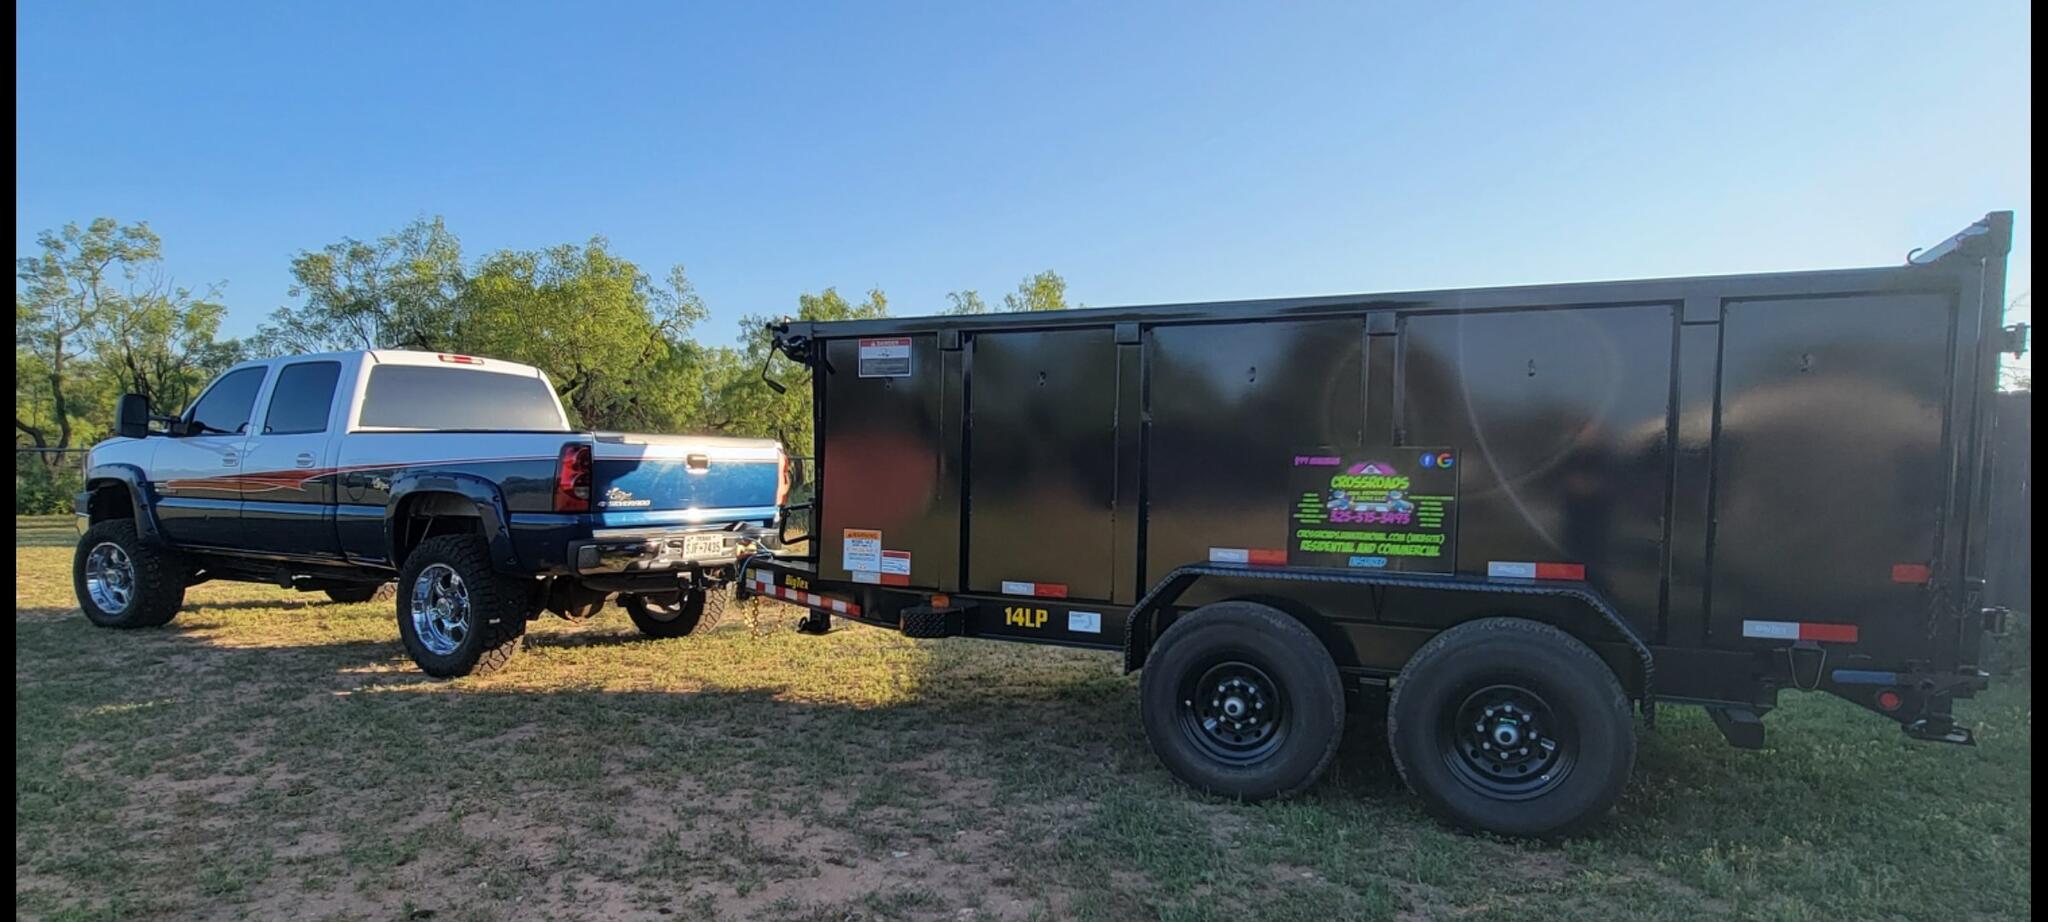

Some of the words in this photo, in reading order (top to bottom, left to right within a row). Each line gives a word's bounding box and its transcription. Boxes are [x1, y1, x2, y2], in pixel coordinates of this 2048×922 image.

[1331, 475, 1409, 490] CROSSROADS
[1300, 540, 1355, 553] RESIDENTIAL
[1356, 543, 1377, 553] AND
[1377, 543, 1440, 556] COMMERCIAL
[1004, 606, 1048, 629] 14LP
